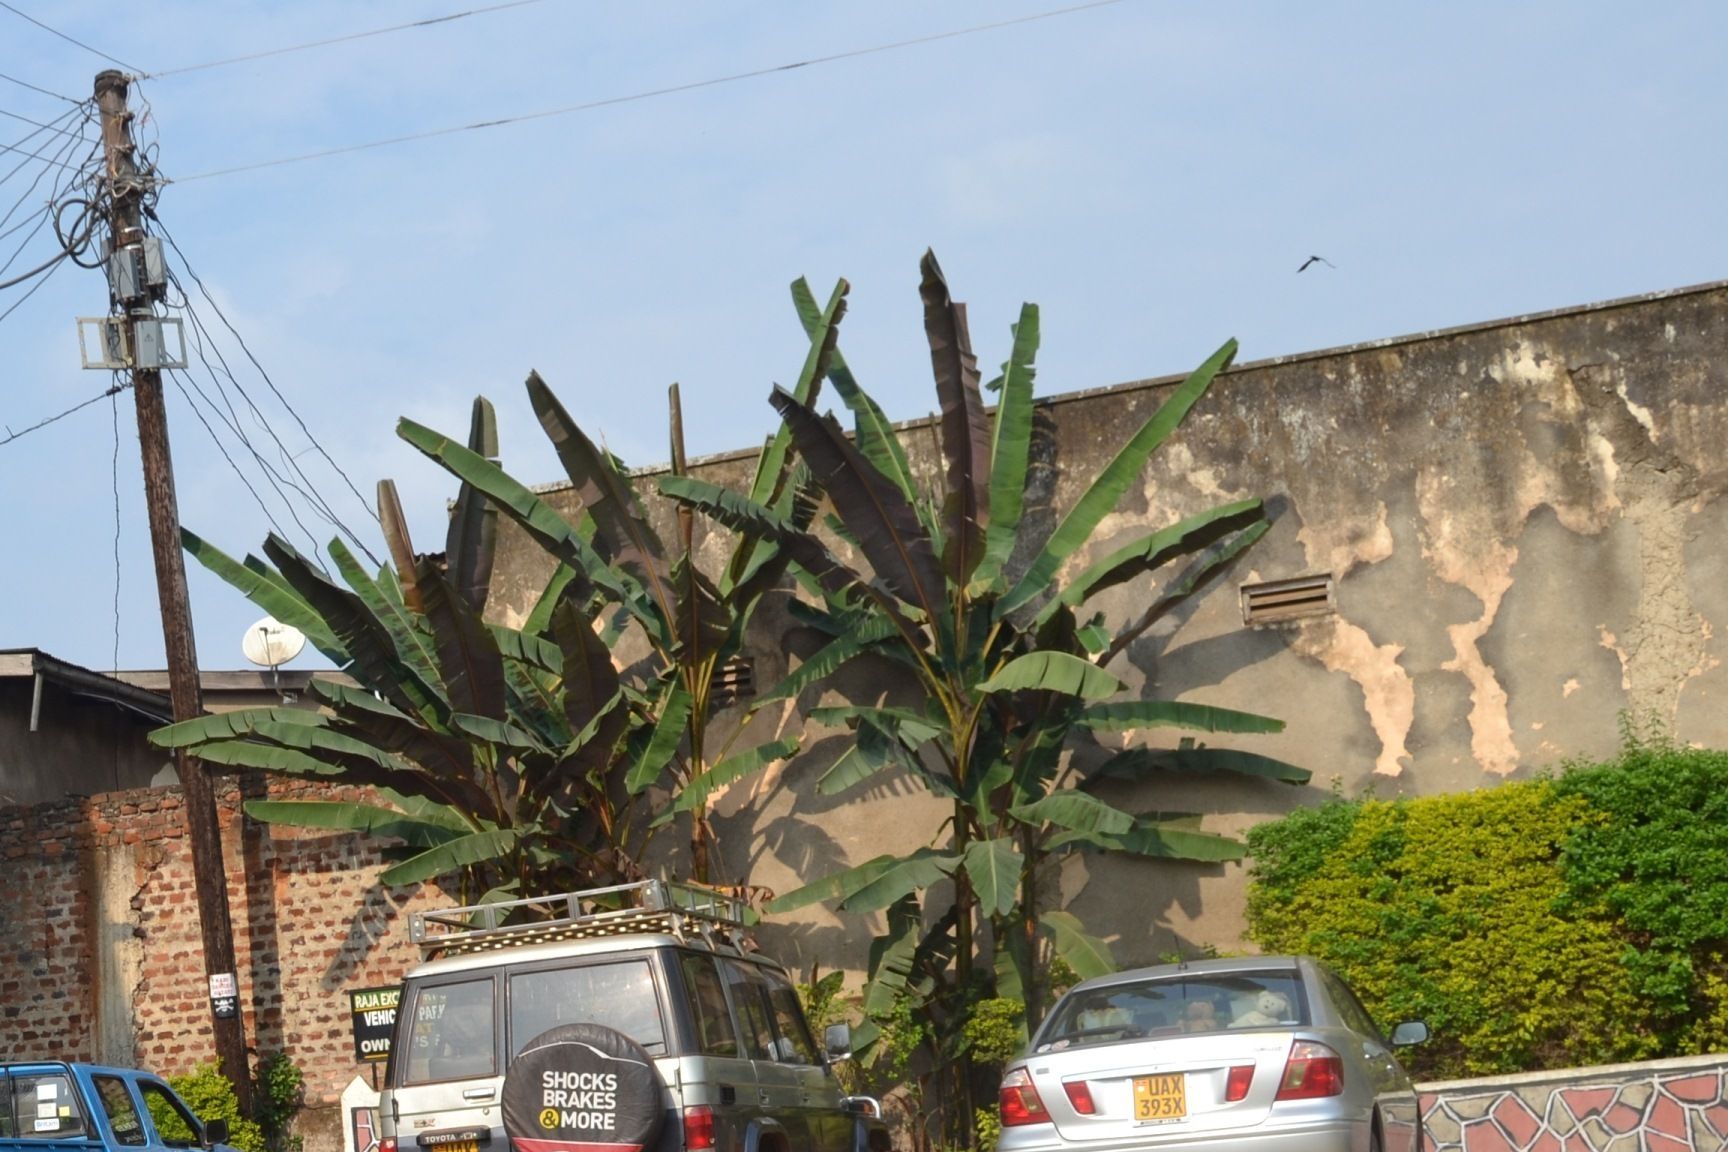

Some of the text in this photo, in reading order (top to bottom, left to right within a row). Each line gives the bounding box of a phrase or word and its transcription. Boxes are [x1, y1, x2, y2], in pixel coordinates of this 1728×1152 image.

[354, 991, 400, 1009] RAJA EXC
[364, 1009, 397, 1027] VEHIC
[542, 1071, 617, 1091] SHOCKS
[1149, 1075, 1182, 1096] UAX
[543, 1089, 616, 1110] BRAKES
[1139, 1097, 1184, 1117] 393X
[561, 1111, 616, 1130] MORE
[425, 1134, 456, 1143] TOYOTA
